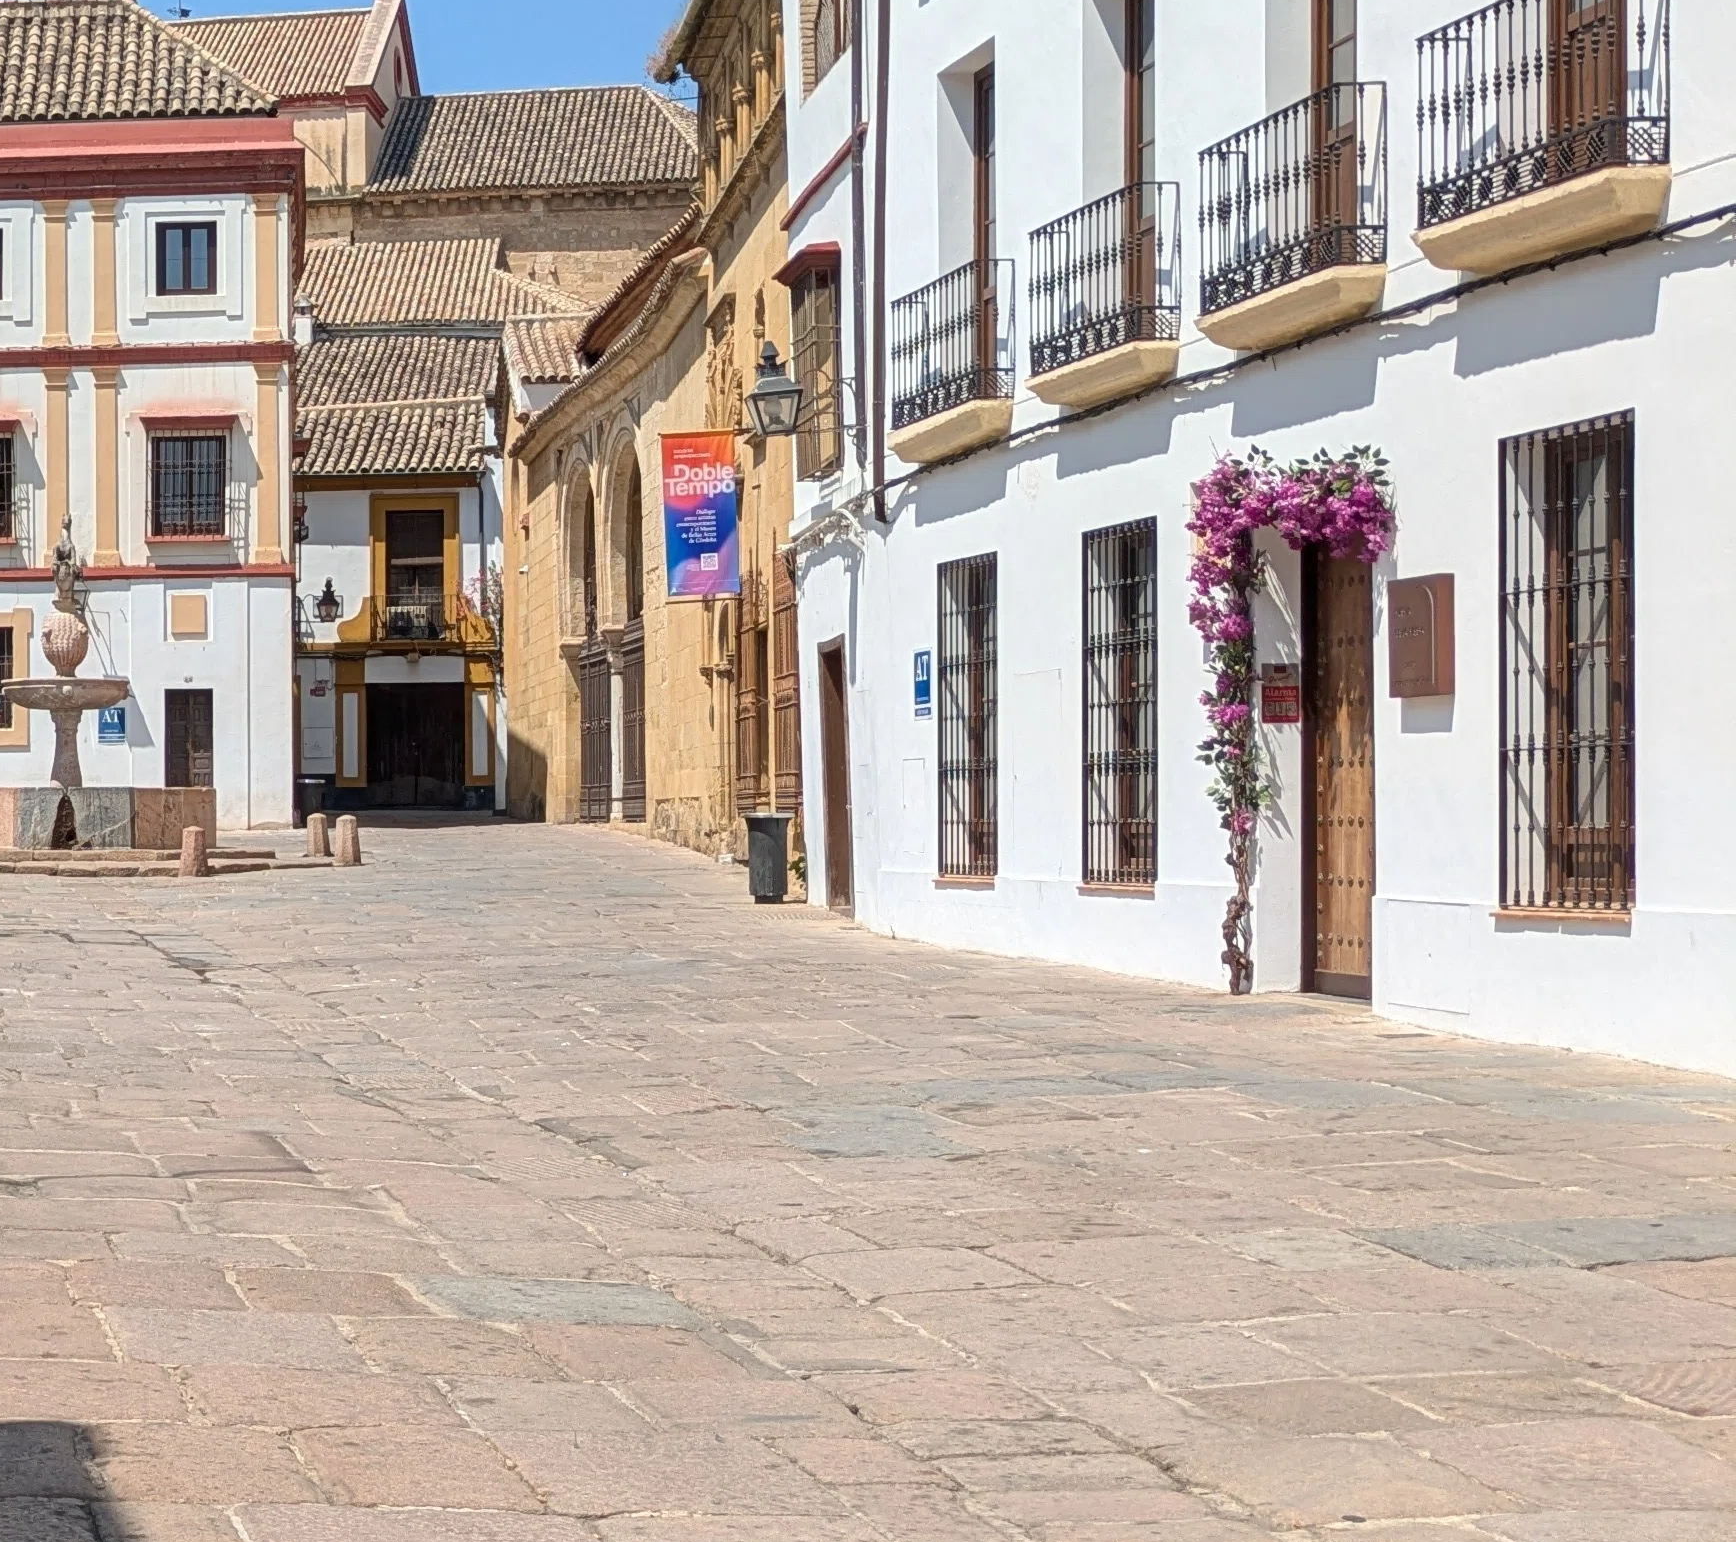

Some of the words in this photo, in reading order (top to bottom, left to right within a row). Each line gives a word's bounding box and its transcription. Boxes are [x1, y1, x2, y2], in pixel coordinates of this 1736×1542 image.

[673, 462, 734, 481] Doble
[665, 479, 735, 498] Tempo
[916, 655, 928, 681] AT
[1265, 688, 1297, 697] Alarma
[102, 709, 122, 723] AT
